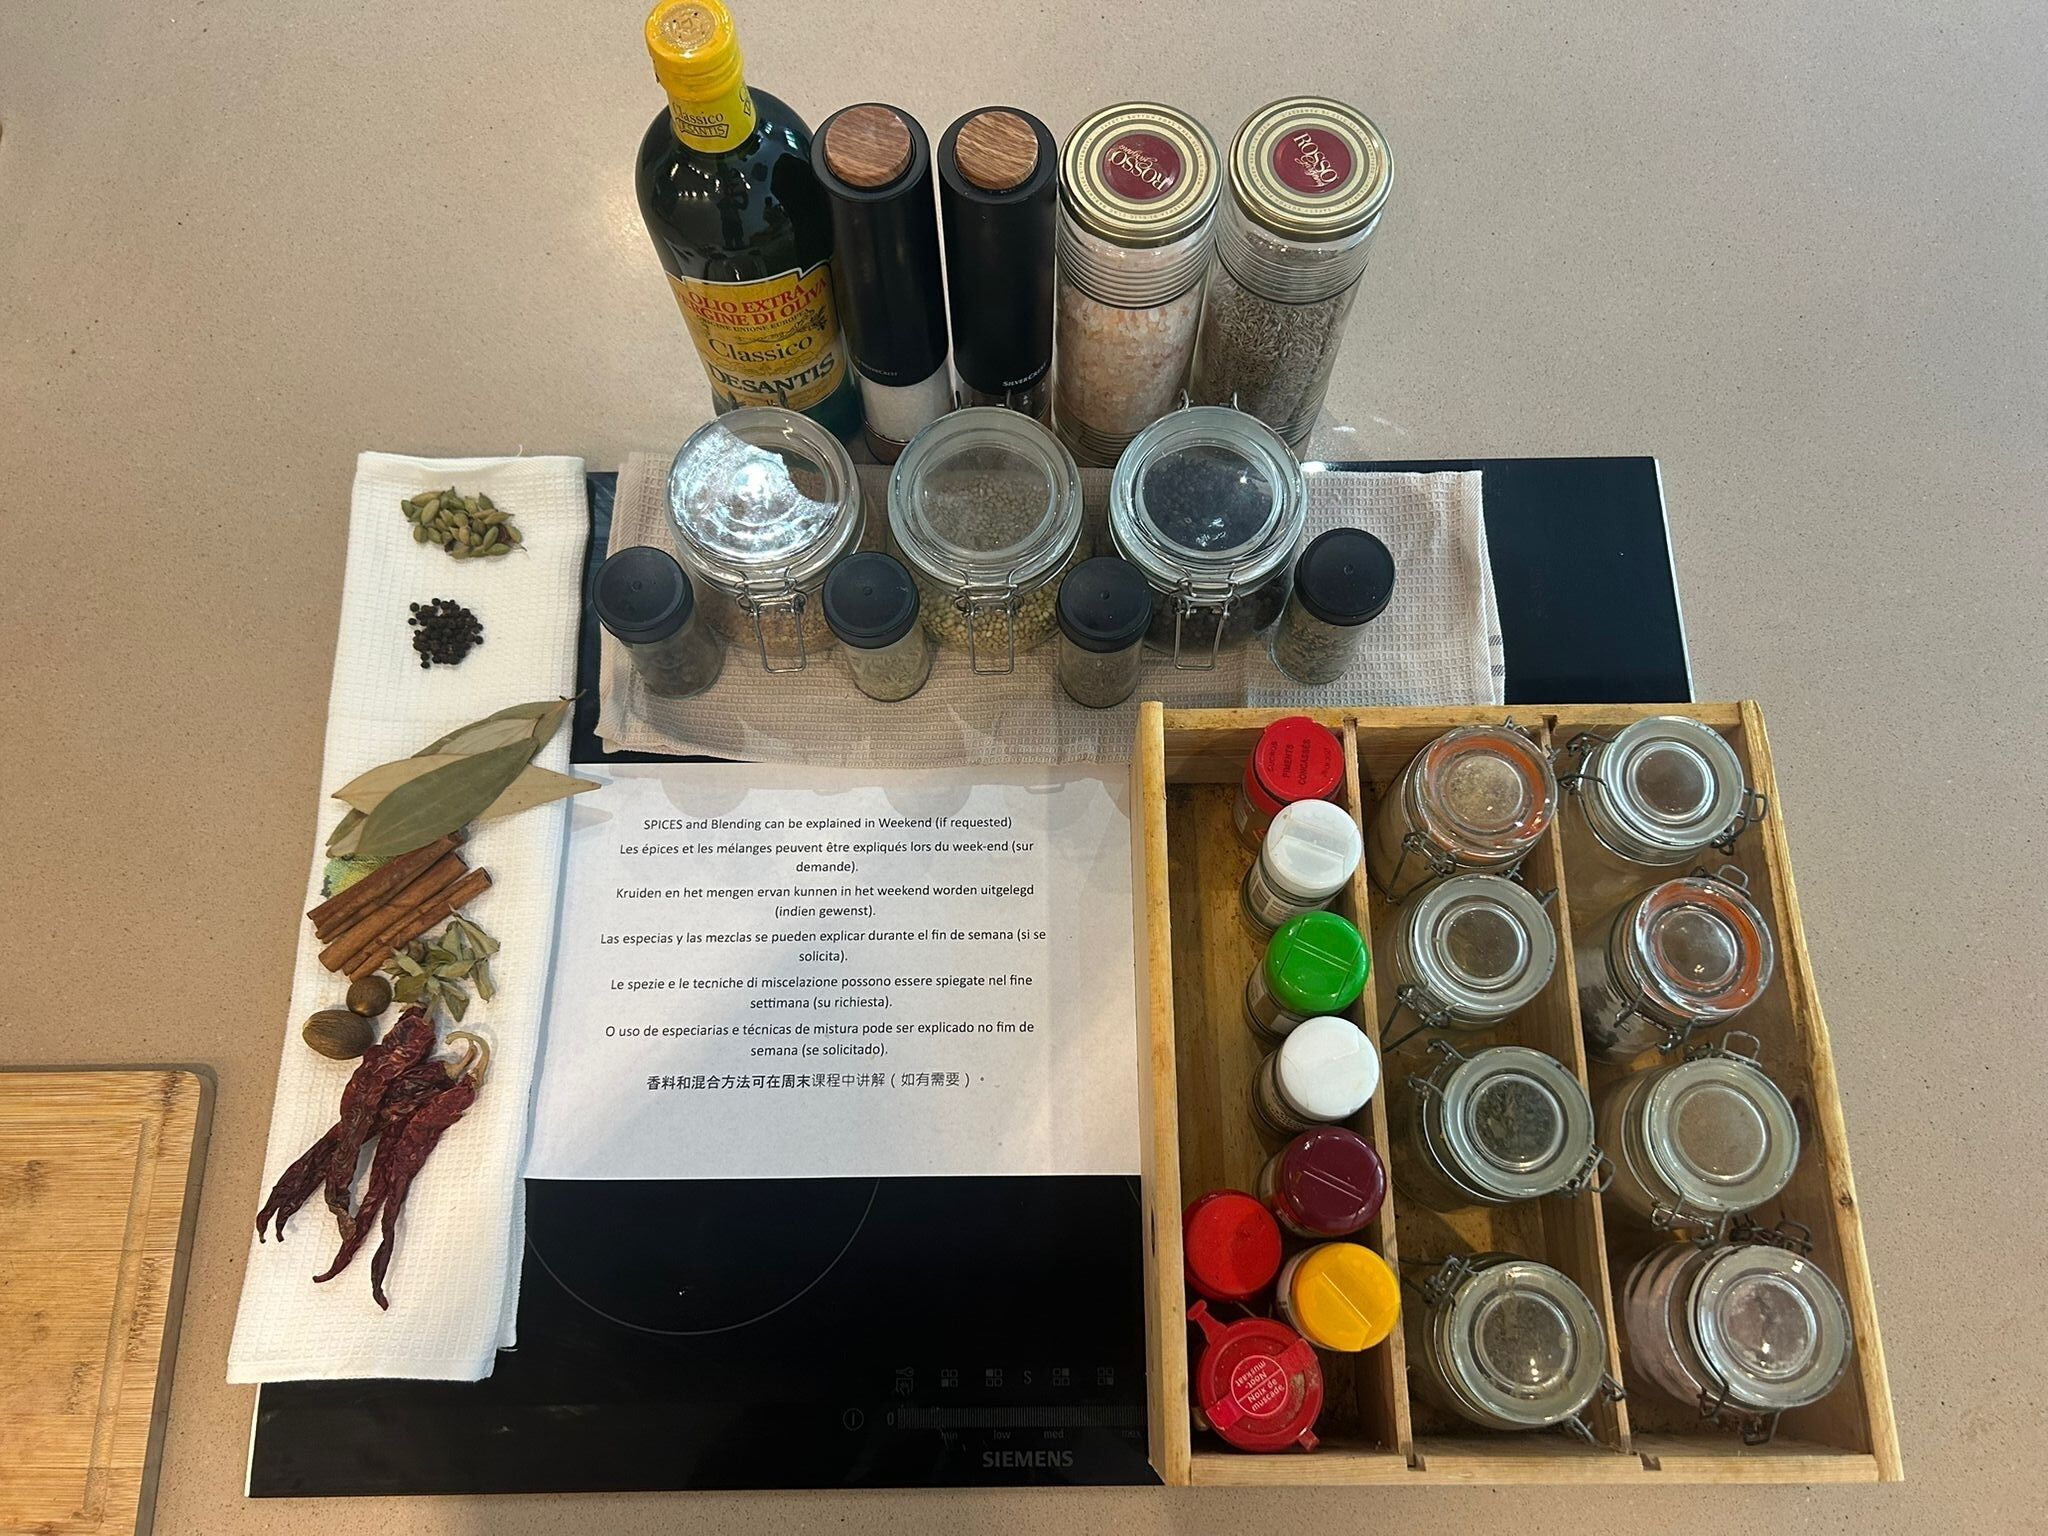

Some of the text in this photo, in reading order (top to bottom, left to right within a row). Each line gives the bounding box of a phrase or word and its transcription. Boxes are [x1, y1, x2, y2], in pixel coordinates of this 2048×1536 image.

[1293, 132, 1338, 183] ROSSO
[1109, 150, 1168, 192] ROSSO
[689, 284, 806, 314] OLIO EXTRA
[751, 310, 776, 326] DI
[780, 277, 829, 317] OLIVA
[708, 335, 813, 363] Classico
[706, 351, 835, 394] DESANTIS
[643, 816, 1013, 832] SPICES and Blending can be explained in Weekend (if requested)
[619, 840, 1035, 857] Les épices et les mélanges peuvent être expliqués lors du week-end (sur
[795, 860, 859, 874] demande).
[615, 883, 1034, 900] Kruiden en het mengen ervan kunnen in het weekend worden uitgelegd
[774, 904, 876, 920] (indien gewenst).
[600, 928, 1047, 947] Las especias y las mezclas se pueden explicar durante el fin de semana (si se
[798, 949, 848, 964] solicita).
[610, 973, 1033, 992] Le spezie e le tecniche di miscelazione possono essere spiegate nel fine
[749, 995, 893, 1011] settimana (su richiesta).
[605, 1020, 1035, 1039] O uso de especiarias e técnicas de mistura pode ser explicado no fim de
[750, 1042, 889, 1059] semana (se solicitado).
[1022, 1369, 1032, 1385] S
[1267, 1378, 1278, 1388] de
[1251, 1384, 1285, 1412] muscade
[993, 1429, 1011, 1440] low
[1043, 1428, 1064, 1440] med
[982, 1449, 1074, 1468] SIEMENS
